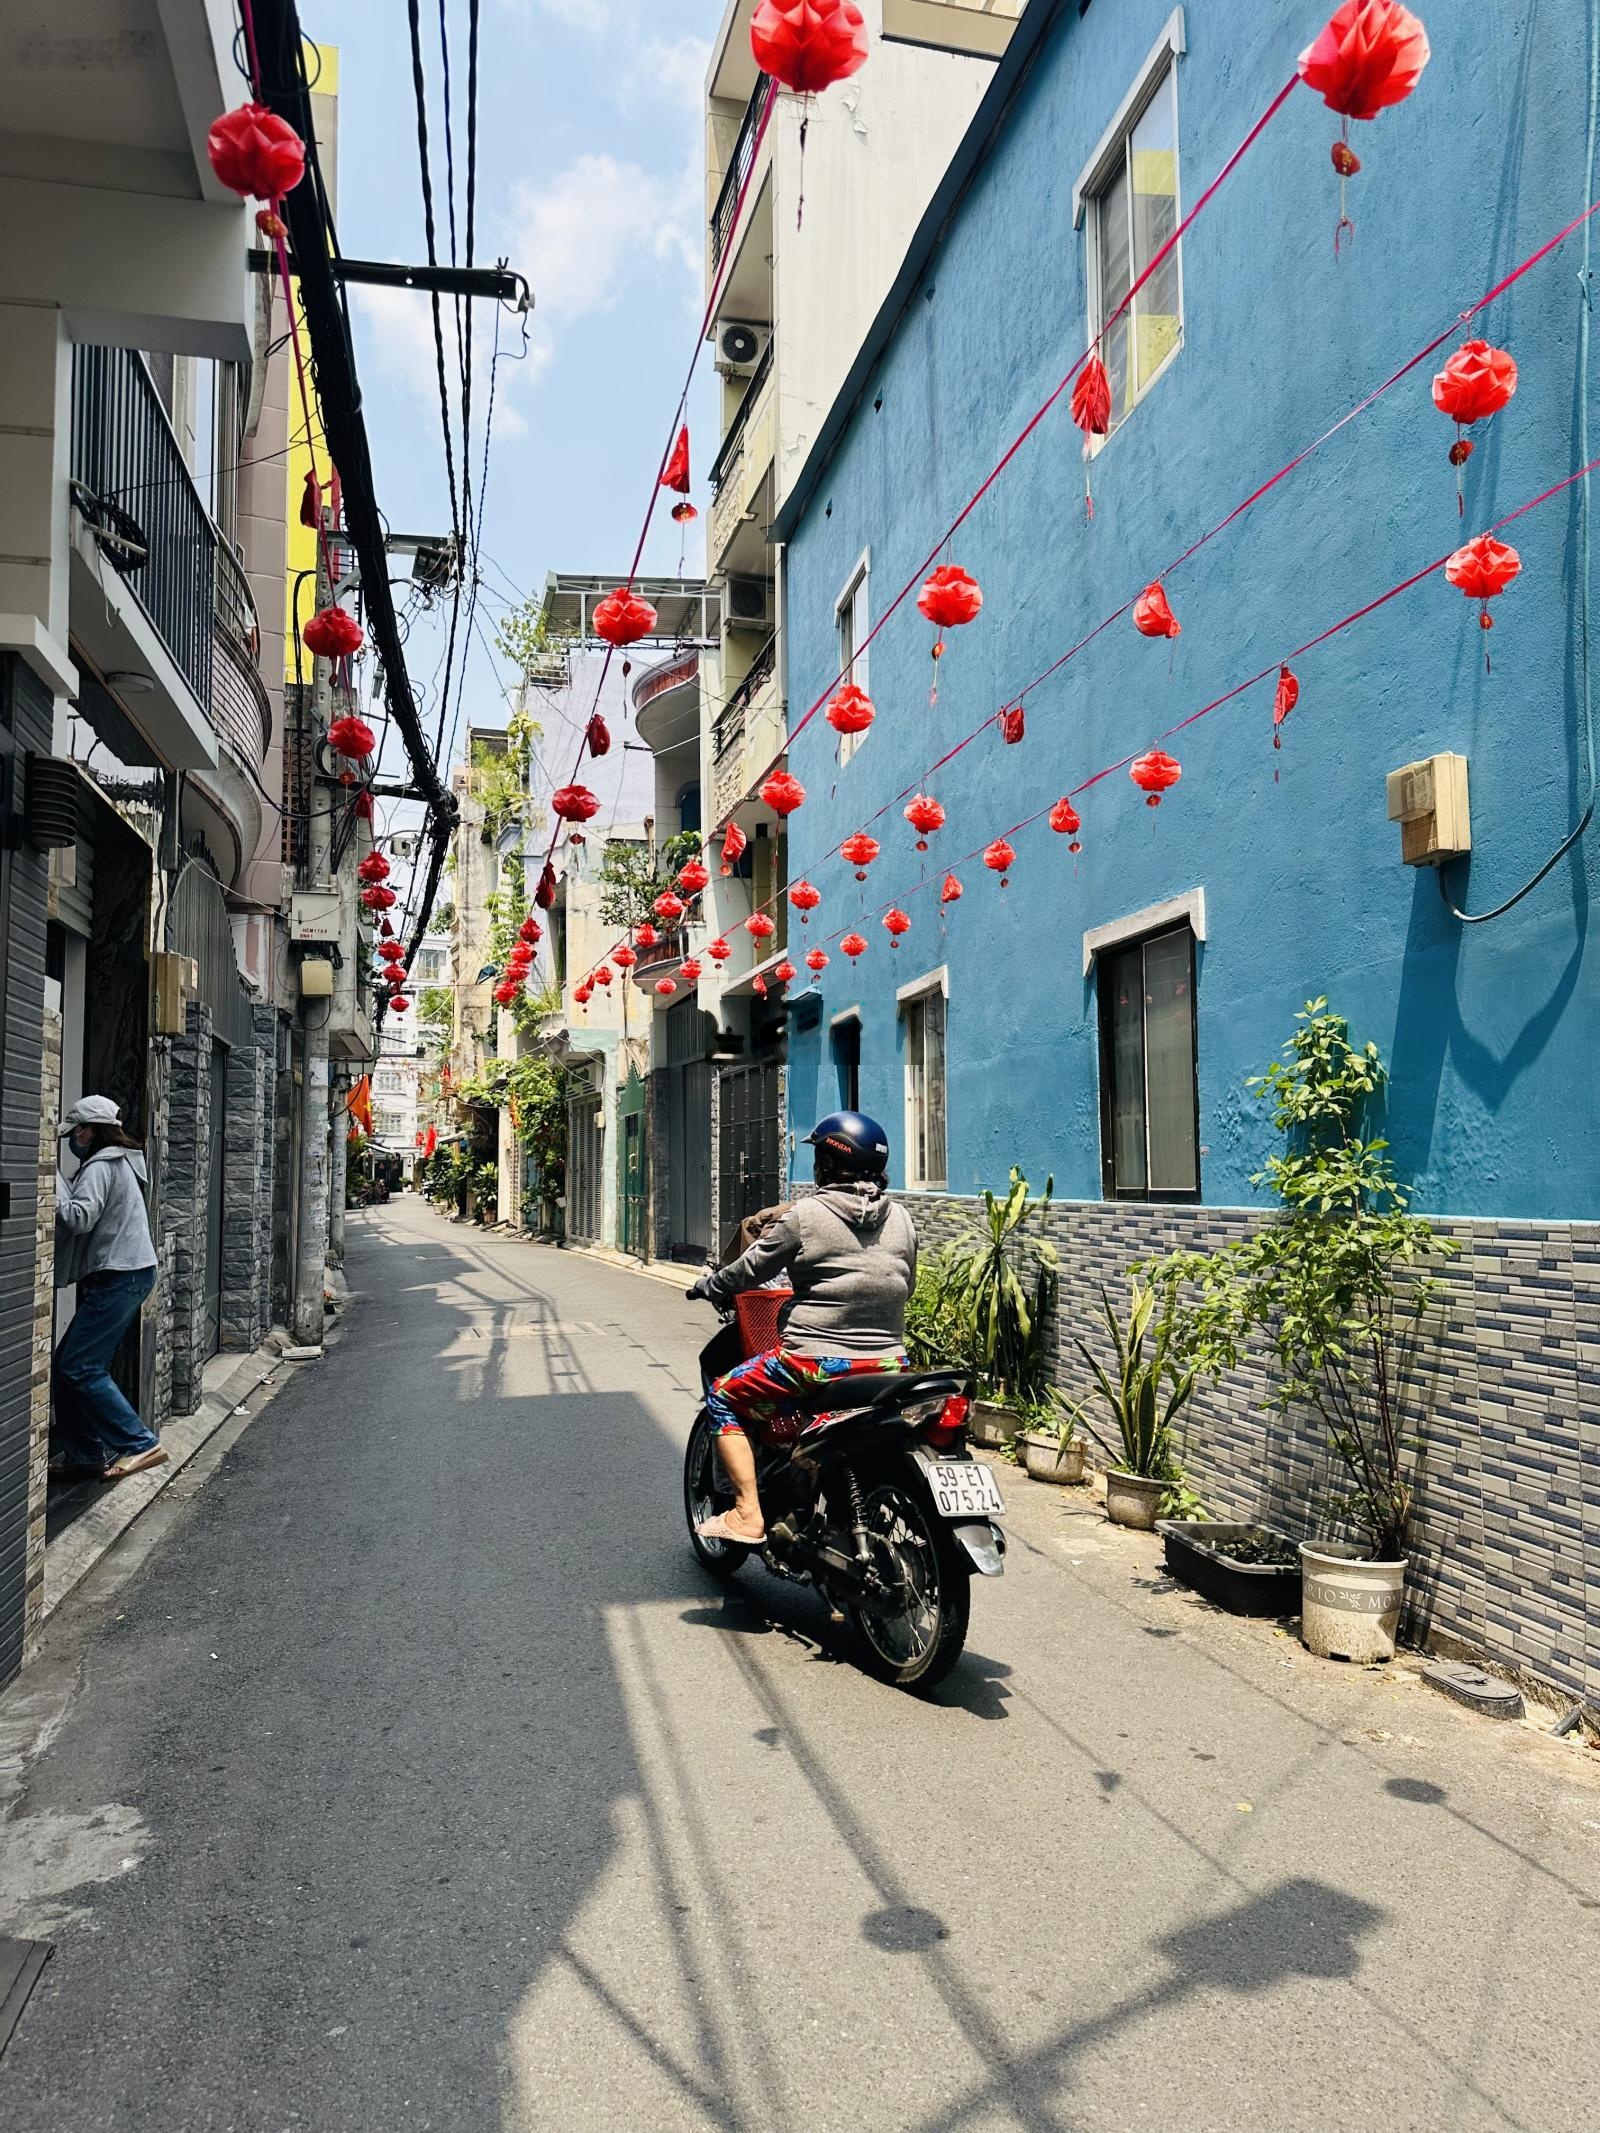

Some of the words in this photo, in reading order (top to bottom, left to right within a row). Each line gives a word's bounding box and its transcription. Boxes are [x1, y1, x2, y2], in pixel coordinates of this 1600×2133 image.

[825, 1137, 852, 1153] HONDA
[935, 1465, 985, 1487] 59-E1
[939, 1488, 1000, 1512] 075.24
